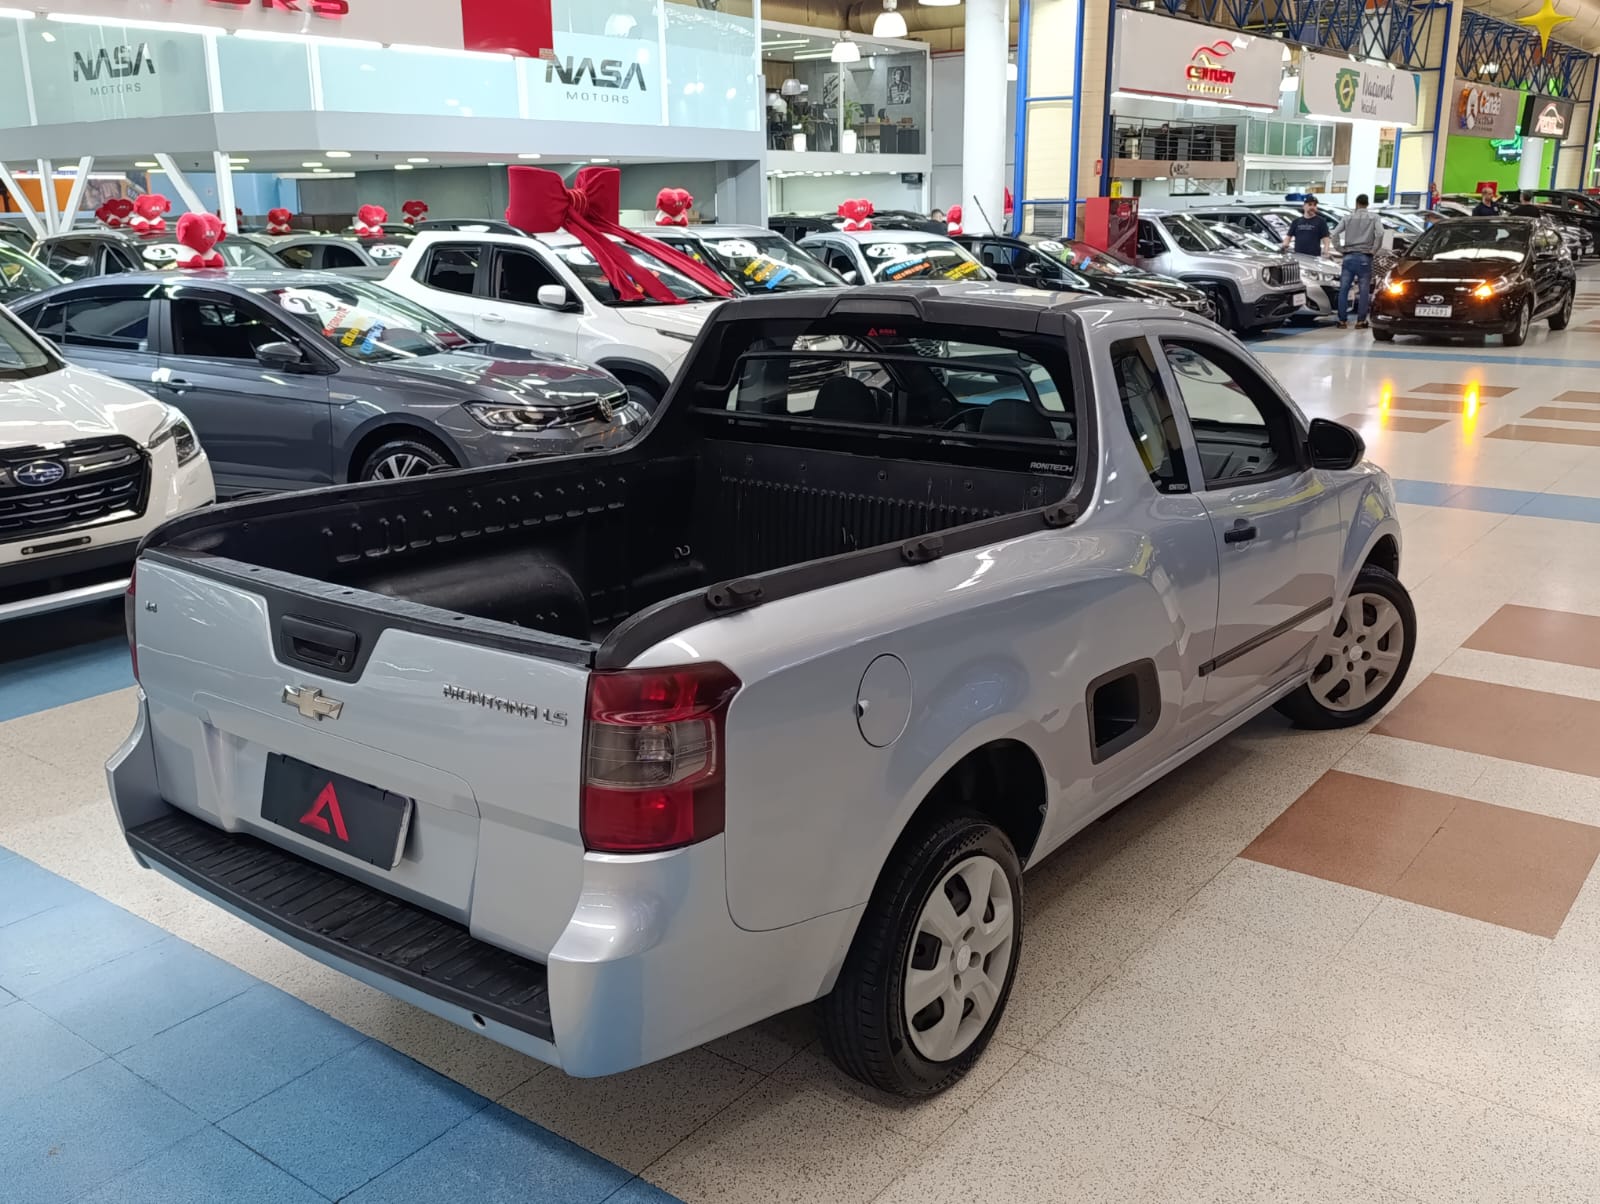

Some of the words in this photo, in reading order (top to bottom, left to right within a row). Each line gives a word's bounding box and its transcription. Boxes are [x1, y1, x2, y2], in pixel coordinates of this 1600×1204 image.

[73, 43, 156, 82] NASA
[545, 55, 647, 92] NASA
[90, 82, 142, 96] MOTORS
[566, 91, 630, 105] MOTORS
[443, 684, 538, 720] MONTANA
[543, 708, 568, 727] LS
